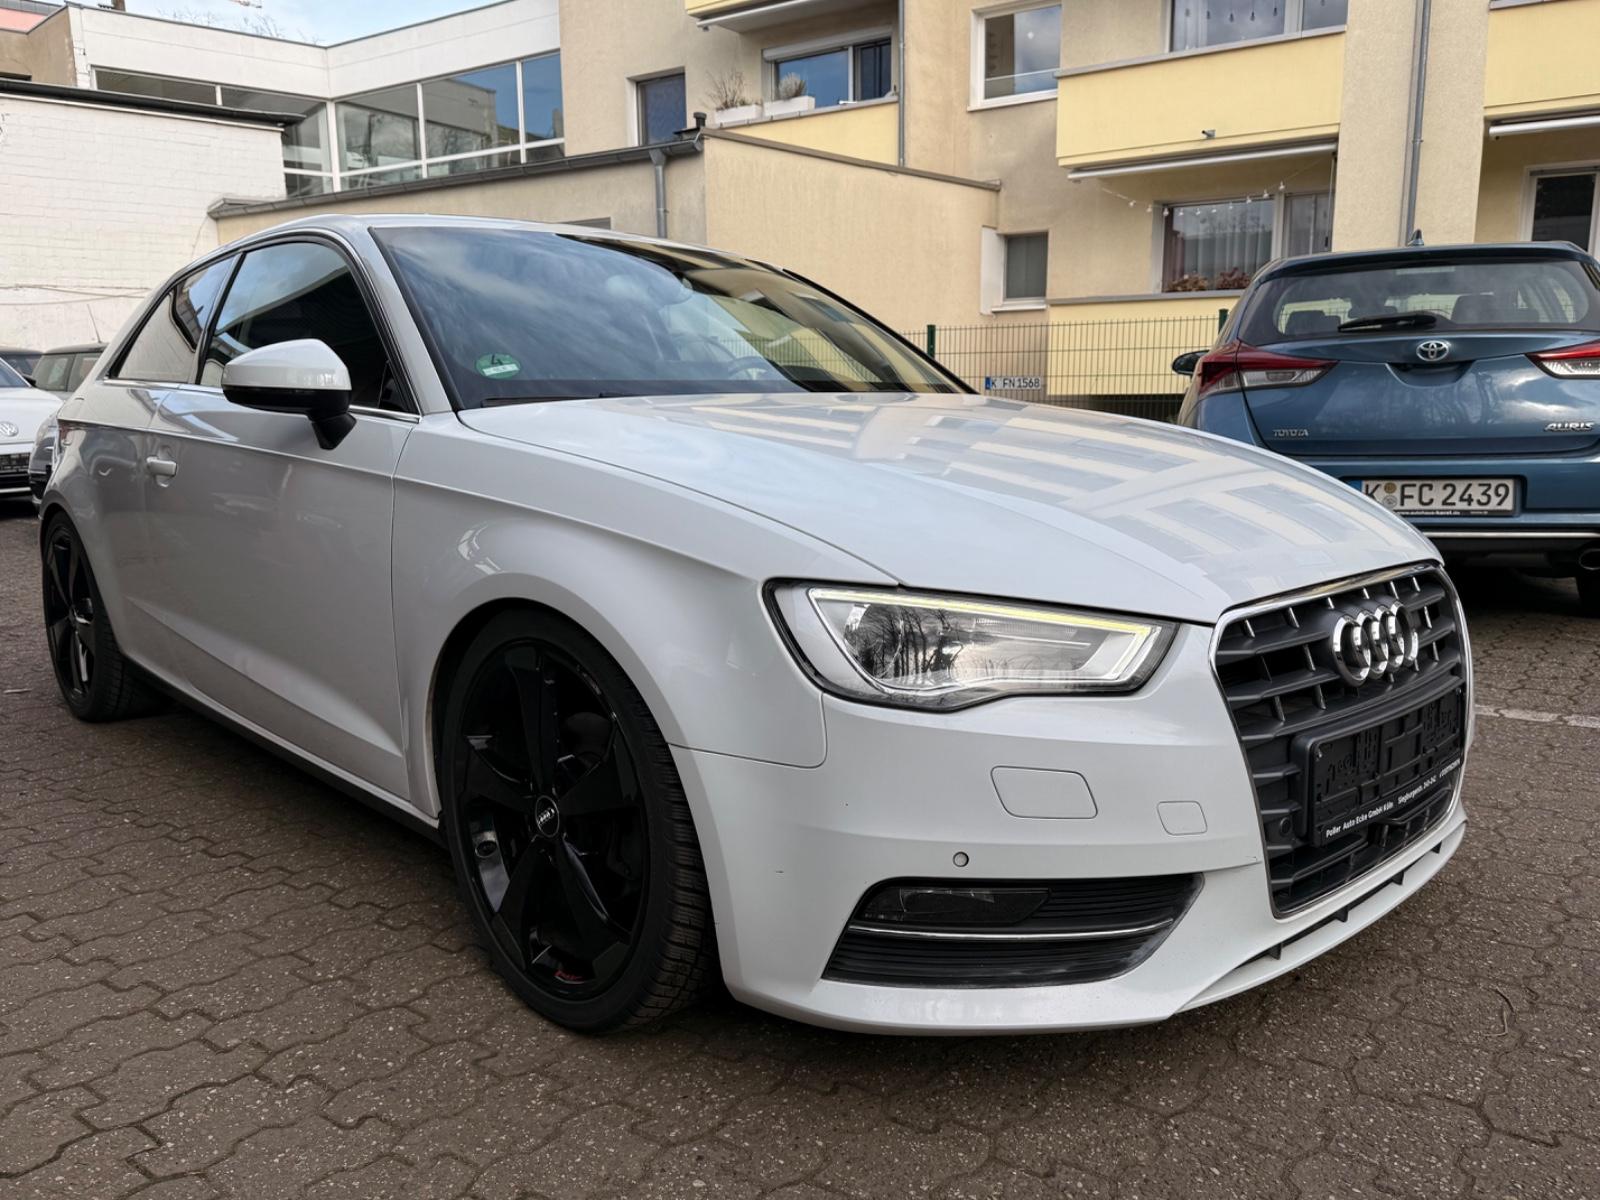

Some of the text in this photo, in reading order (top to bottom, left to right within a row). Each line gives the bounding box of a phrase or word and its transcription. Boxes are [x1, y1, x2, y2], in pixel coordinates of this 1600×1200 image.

[991, 378, 1040, 388] K FN 1568
[1544, 421, 1595, 431] AURIS
[1272, 429, 1309, 437] TOYOTA
[1364, 483, 1510, 506] K FC 2439
[1343, 819, 1355, 830] Auto
